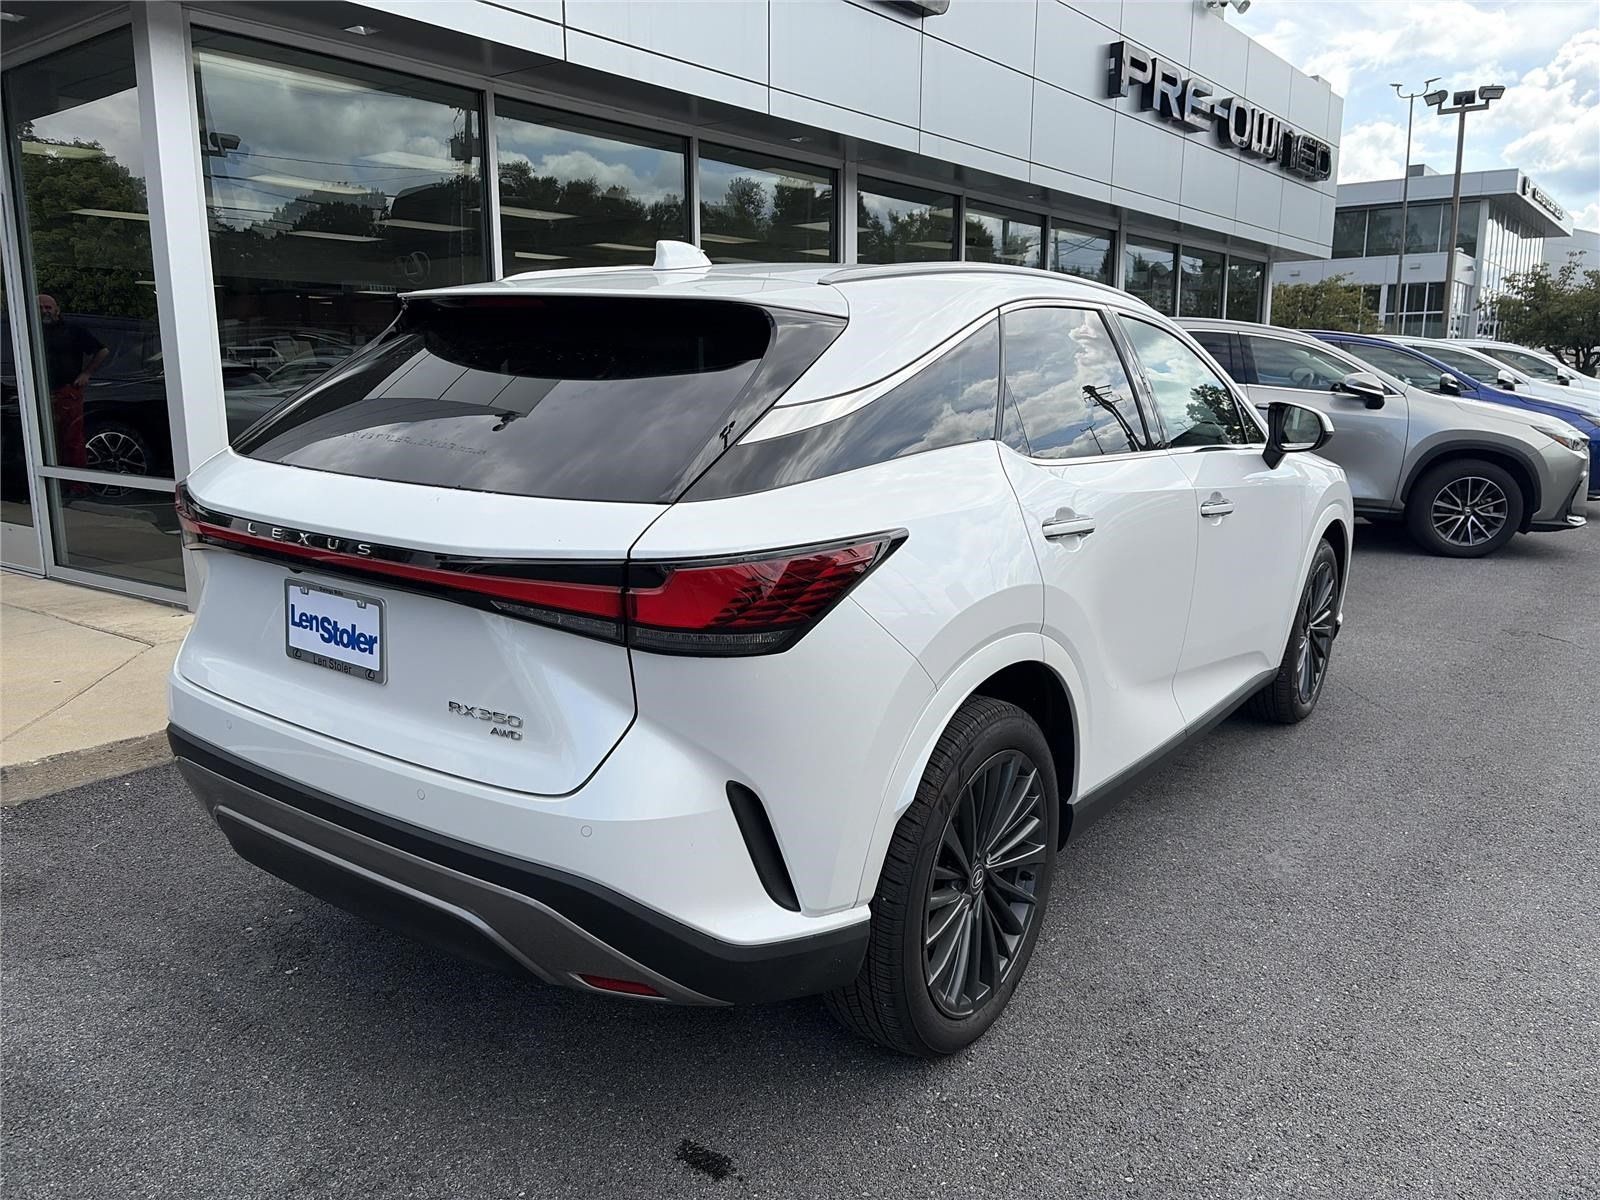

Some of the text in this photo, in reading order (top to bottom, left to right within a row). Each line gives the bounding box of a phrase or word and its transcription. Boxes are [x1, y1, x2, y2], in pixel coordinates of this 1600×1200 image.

[1110, 41, 1332, 181] PRE-OWNED
[247, 522, 371, 555] LEXUS
[313, 655, 352, 674] Len Stoler
[490, 727, 523, 741] AWD
